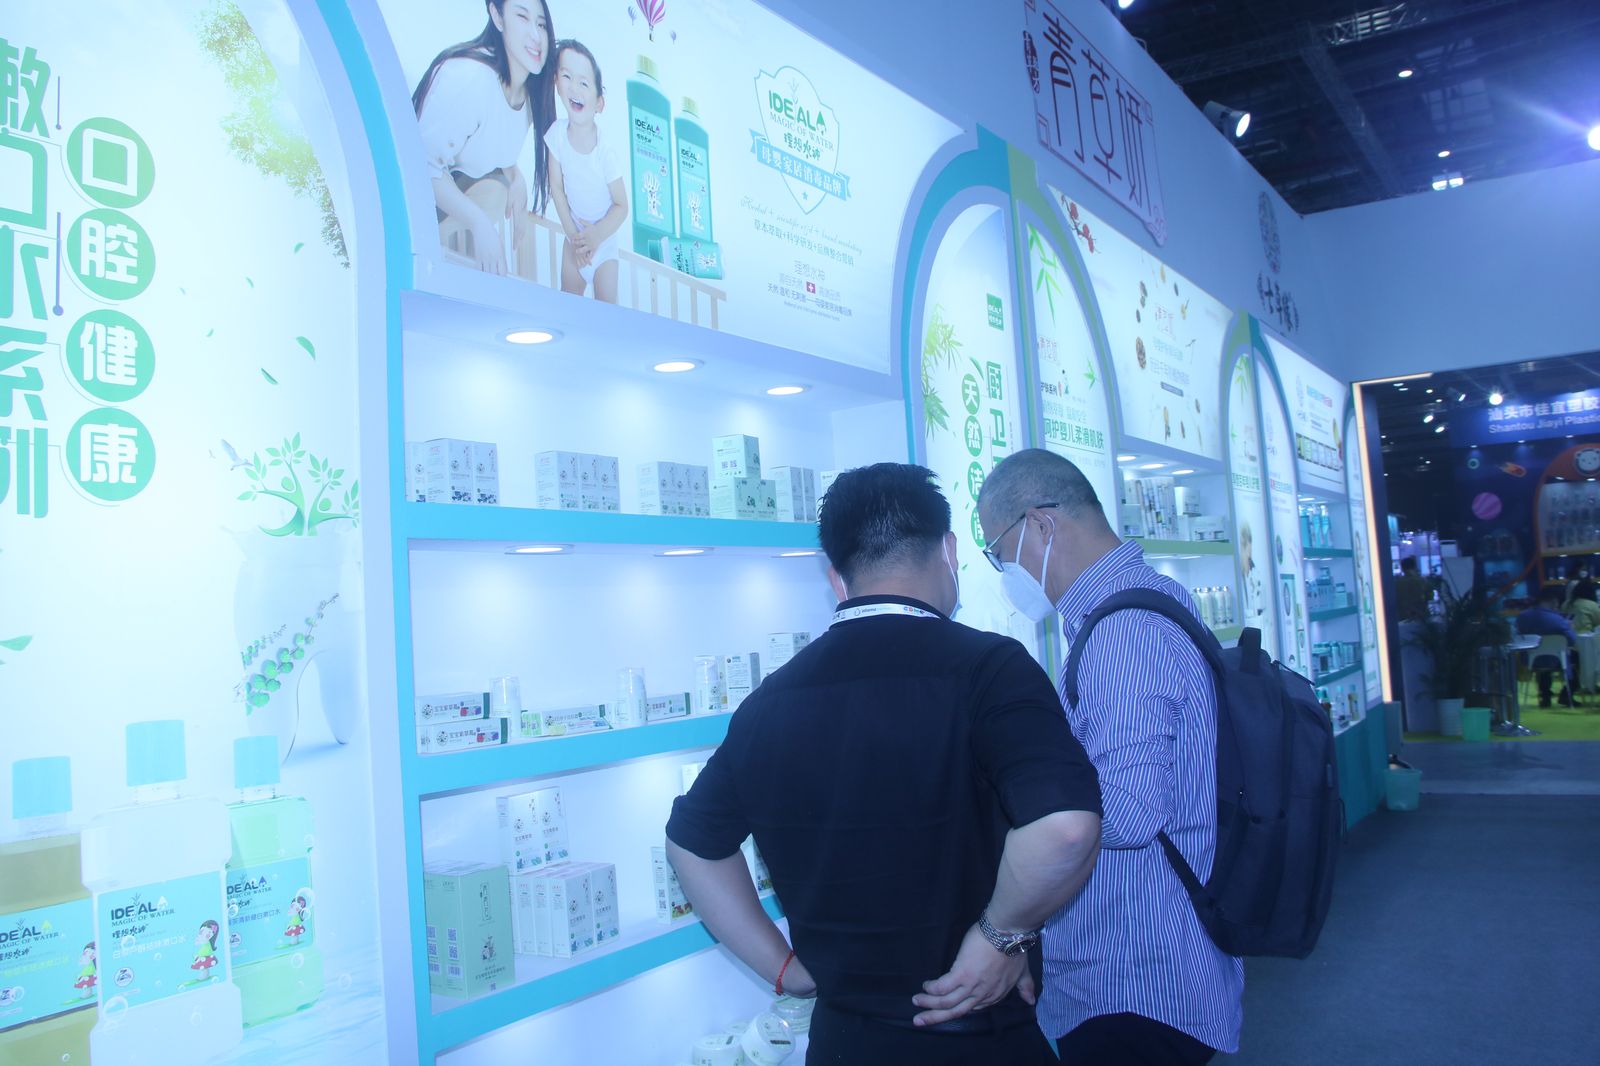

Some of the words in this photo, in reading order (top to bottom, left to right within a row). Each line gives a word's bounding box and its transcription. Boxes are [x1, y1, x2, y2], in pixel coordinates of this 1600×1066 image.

[79, 128, 139, 484] 口腔健康
[1488, 422, 1536, 434] Shantou
[112, 917, 136, 928] MAGIC
[149, 908, 175, 919] WATER
